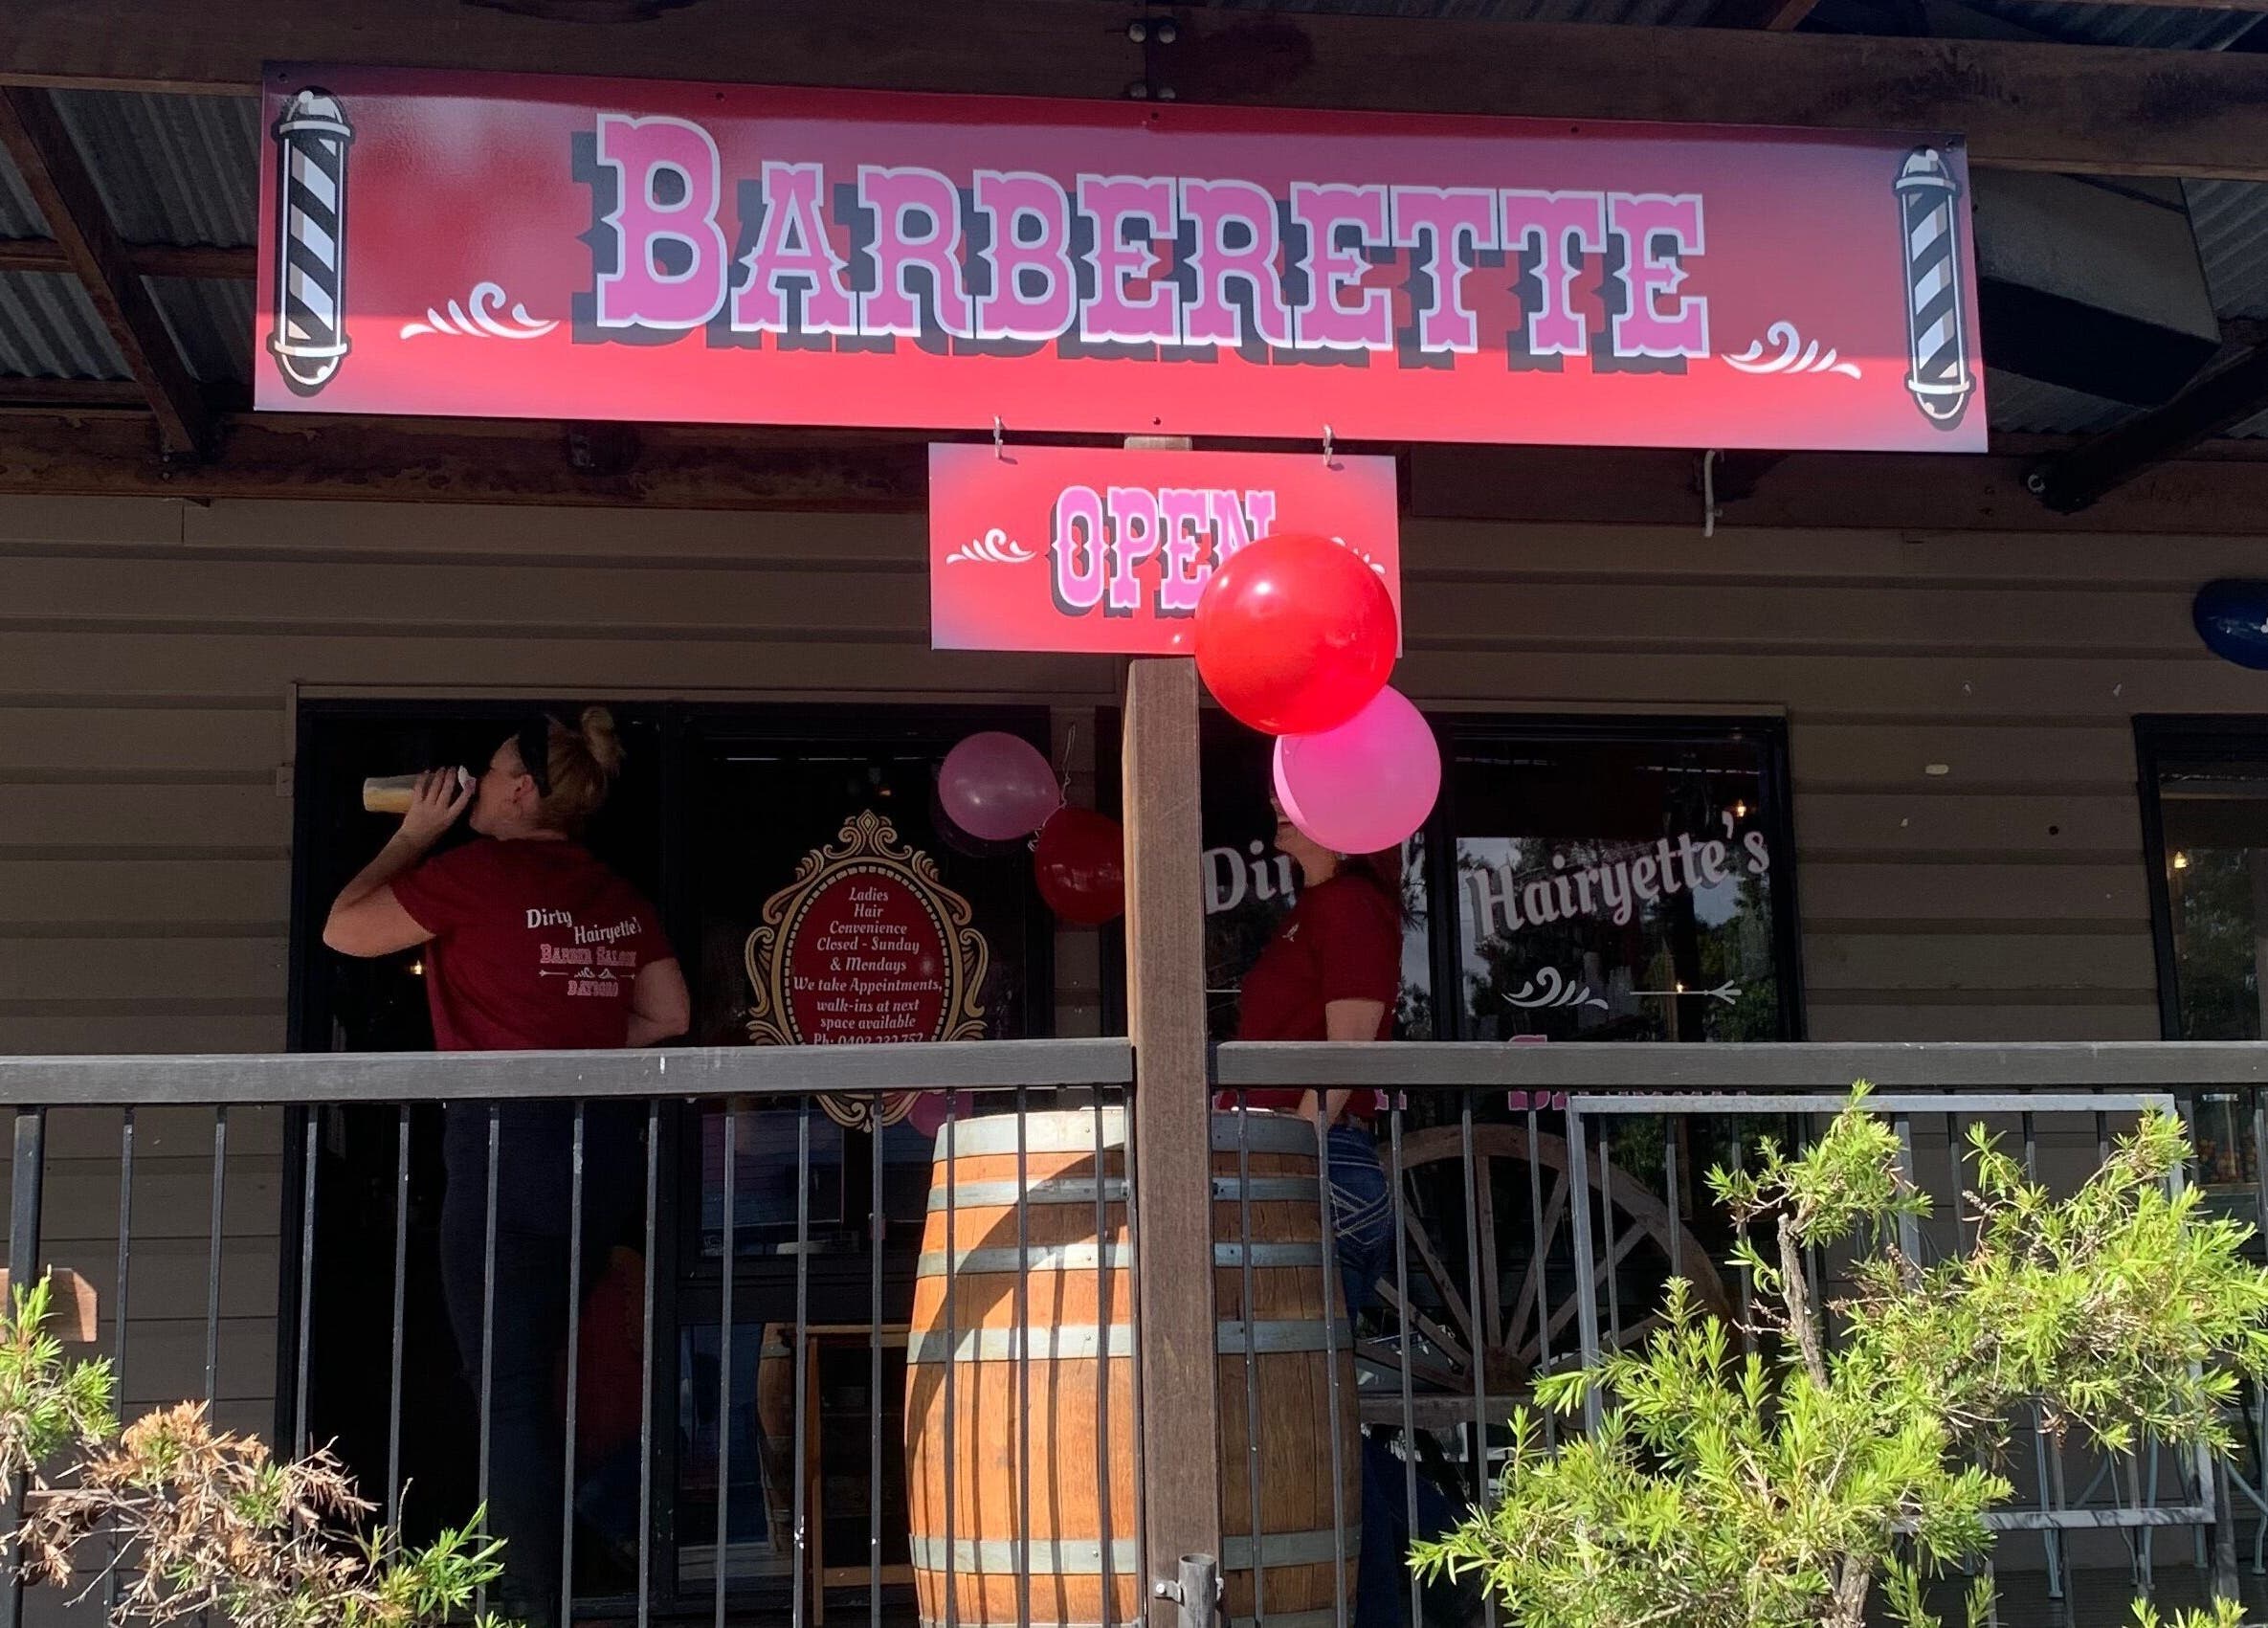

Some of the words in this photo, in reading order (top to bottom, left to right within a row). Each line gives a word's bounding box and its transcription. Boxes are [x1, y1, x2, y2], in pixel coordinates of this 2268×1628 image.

[595, 112, 1711, 360] BARBERETTE
[1466, 811, 1769, 936] Hairyette's
[849, 886, 889, 902] Ladies
[525, 908, 573, 929] Dirty
[854, 903, 884, 918] Hair
[829, 920, 907, 935] Convenience
[816, 936, 858, 951] Closed
[871, 936, 920, 955] Sunday
[830, 956, 841, 971] &
[845, 956, 907, 975] Mondays
[792, 976, 814, 992] We
[817, 976, 847, 992] take
[849, 977, 943, 995] Appointments,
[816, 997, 874, 1013] walk-ins
[876, 1000, 890, 1013] at
[892, 998, 920, 1013] next
[820, 1016, 856, 1031] space
[857, 1013, 916, 1030] available
